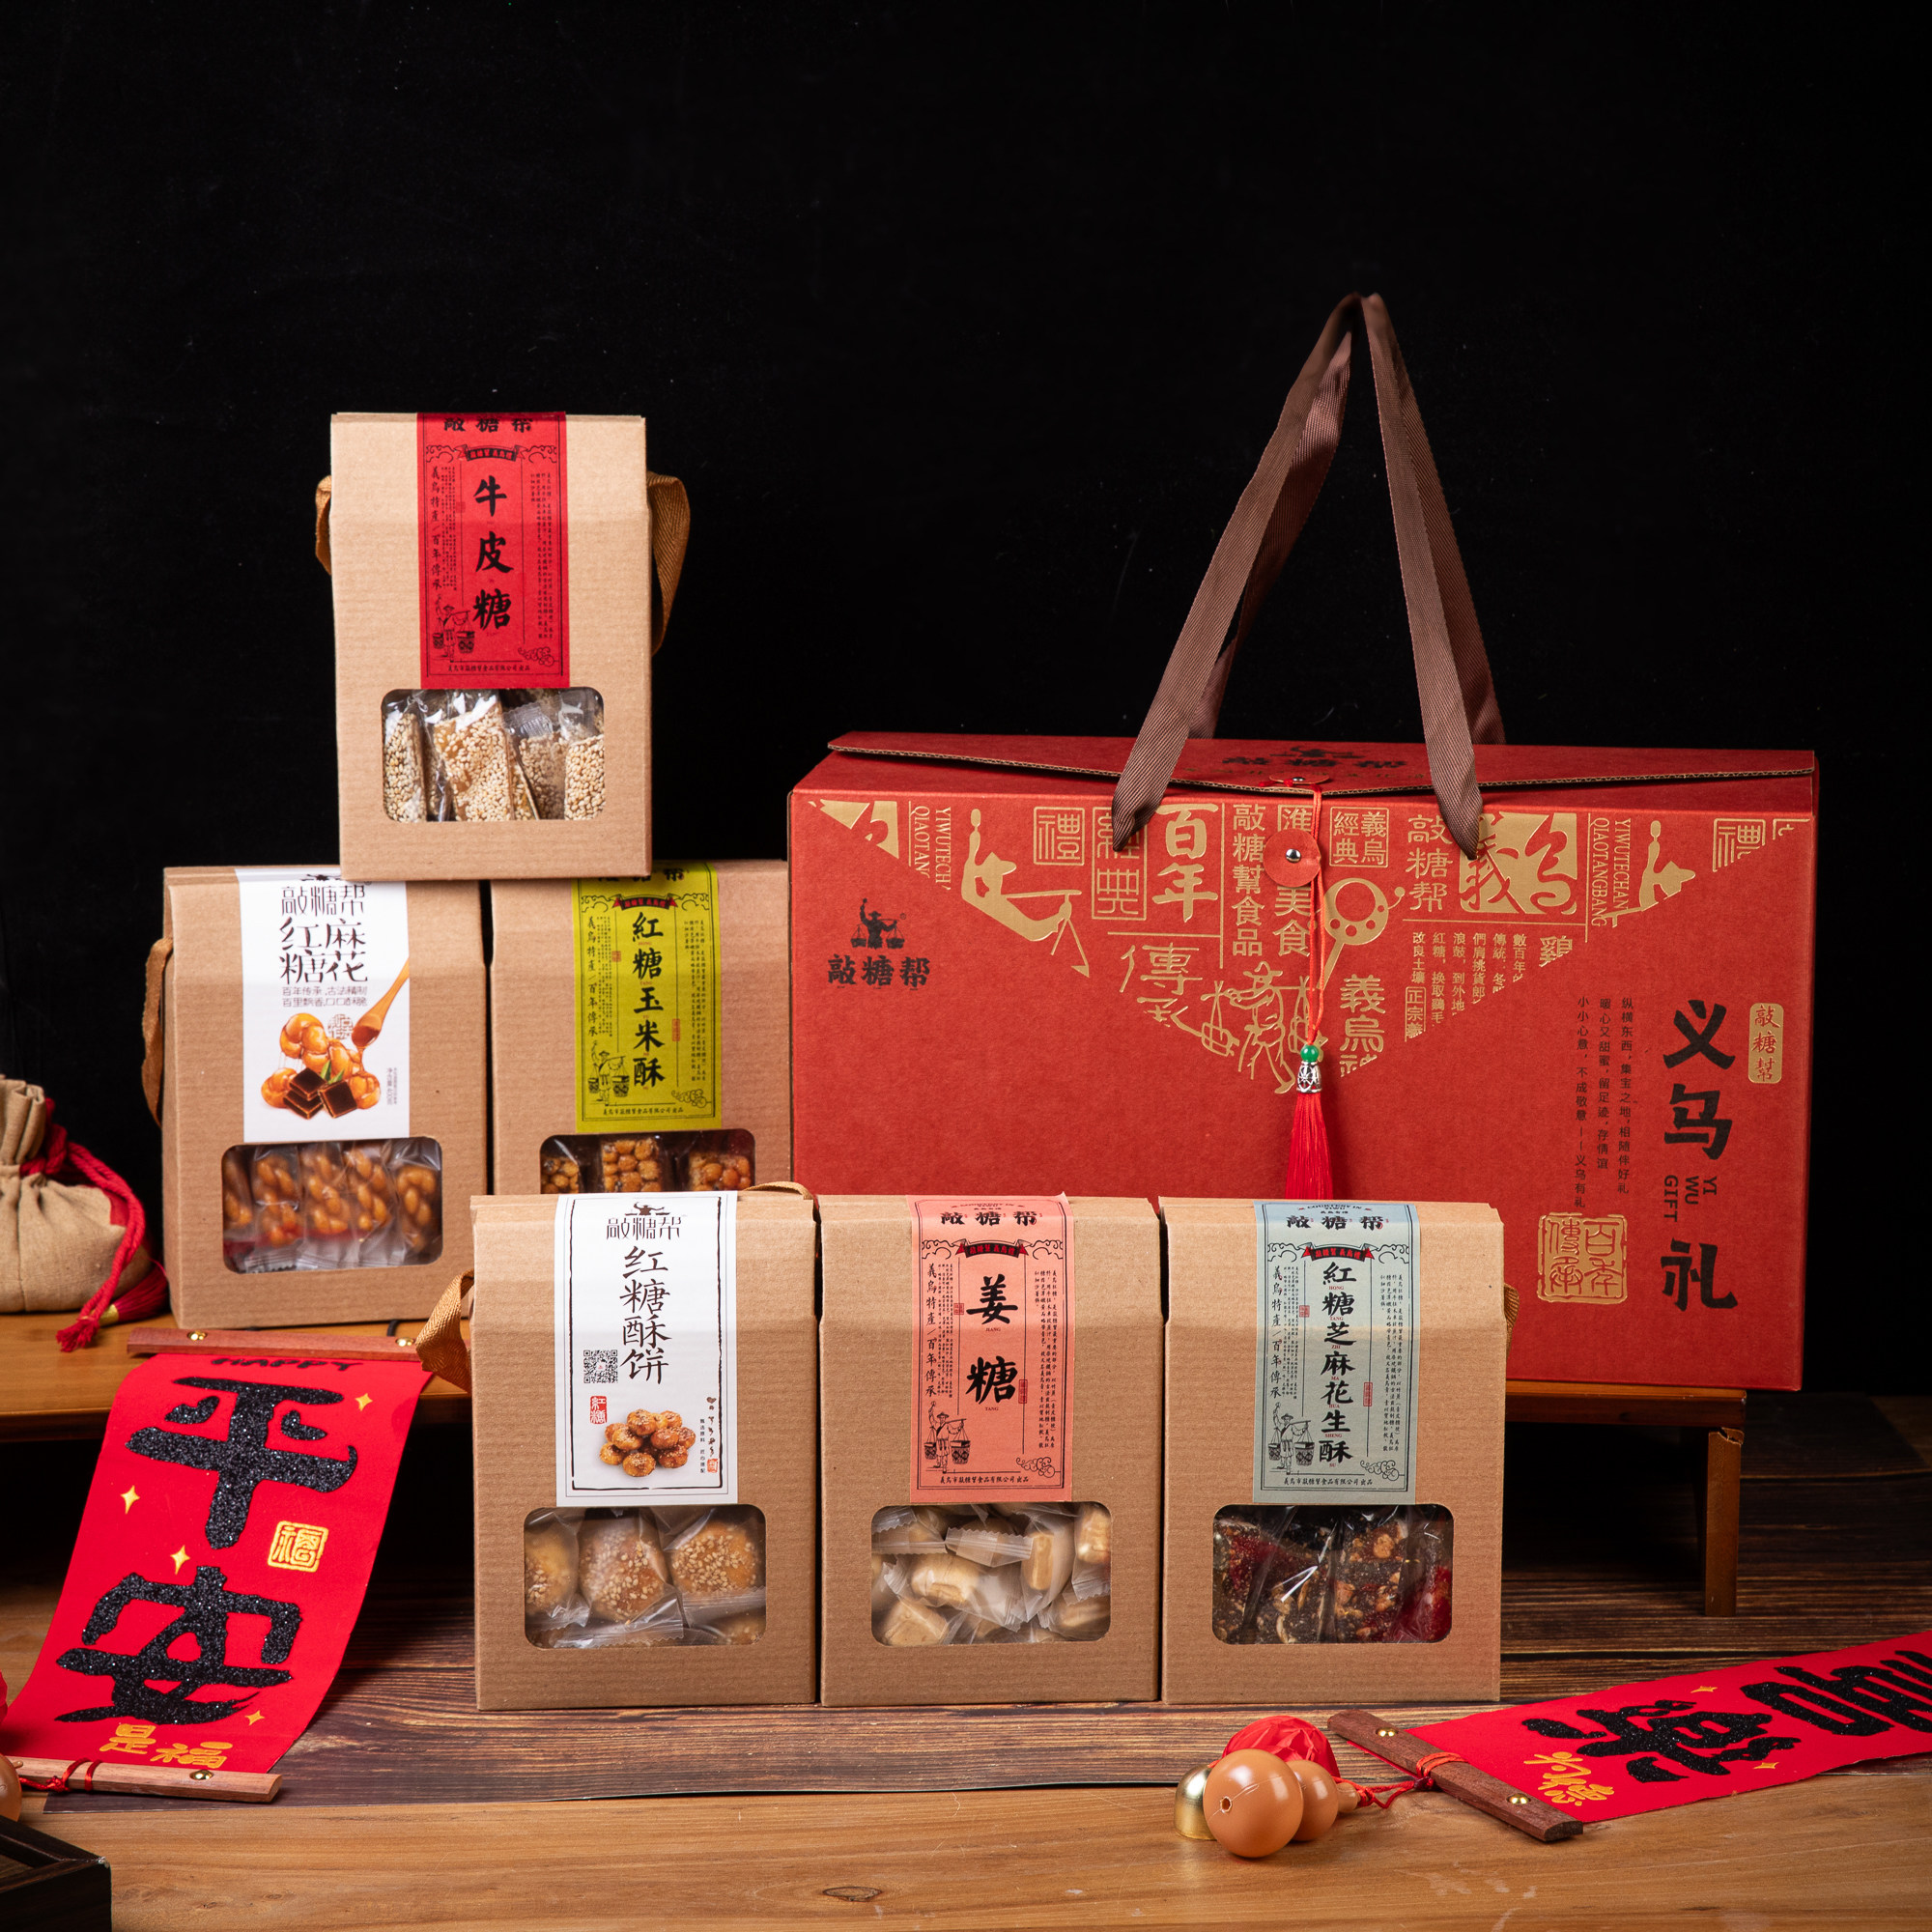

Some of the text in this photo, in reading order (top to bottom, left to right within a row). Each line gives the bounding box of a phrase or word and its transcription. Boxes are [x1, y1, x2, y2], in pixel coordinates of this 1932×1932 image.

[472, 474, 514, 630] 牛皮糖
[912, 805, 930, 879] QIAOTAN
[935, 807, 952, 891] YIWUTECH
[1152, 803, 1219, 923] 百年
[1333, 811, 1360, 864] 經典
[1360, 810, 1387, 865] 義烏
[1406, 814, 1453, 912] 敲糖帮
[1612, 817, 1632, 910] YIWUTECHAN
[281, 885, 366, 917] 敲糖帮
[827, 953, 930, 988] 敲糖帮
[1411, 931, 1426, 983] 改良土壤
[1451, 931, 1466, 1016] 浪鼓，到外地
[1471, 932, 1487, 1004] 們肩挑貨郎
[632, 912, 667, 1088] 紅糖玉米酥
[1661, 999, 1739, 1312] 义乌礼
[1685, 1176, 1699, 1205] WU
[1703, 1176, 1718, 1195] YI
[606, 1217, 681, 1240] 敲糖帮
[1663, 1175, 1679, 1222] GIFT
[619, 1245, 672, 1385] 红糖酥饼
[966, 1273, 1018, 1405] 姜糖
[1319, 1262, 1356, 1463] 紅糖芝麻花生酥
[55, 1376, 358, 1725] 平安
[270, 1521, 327, 1571] 福
[99, 1723, 233, 1769] 是福
